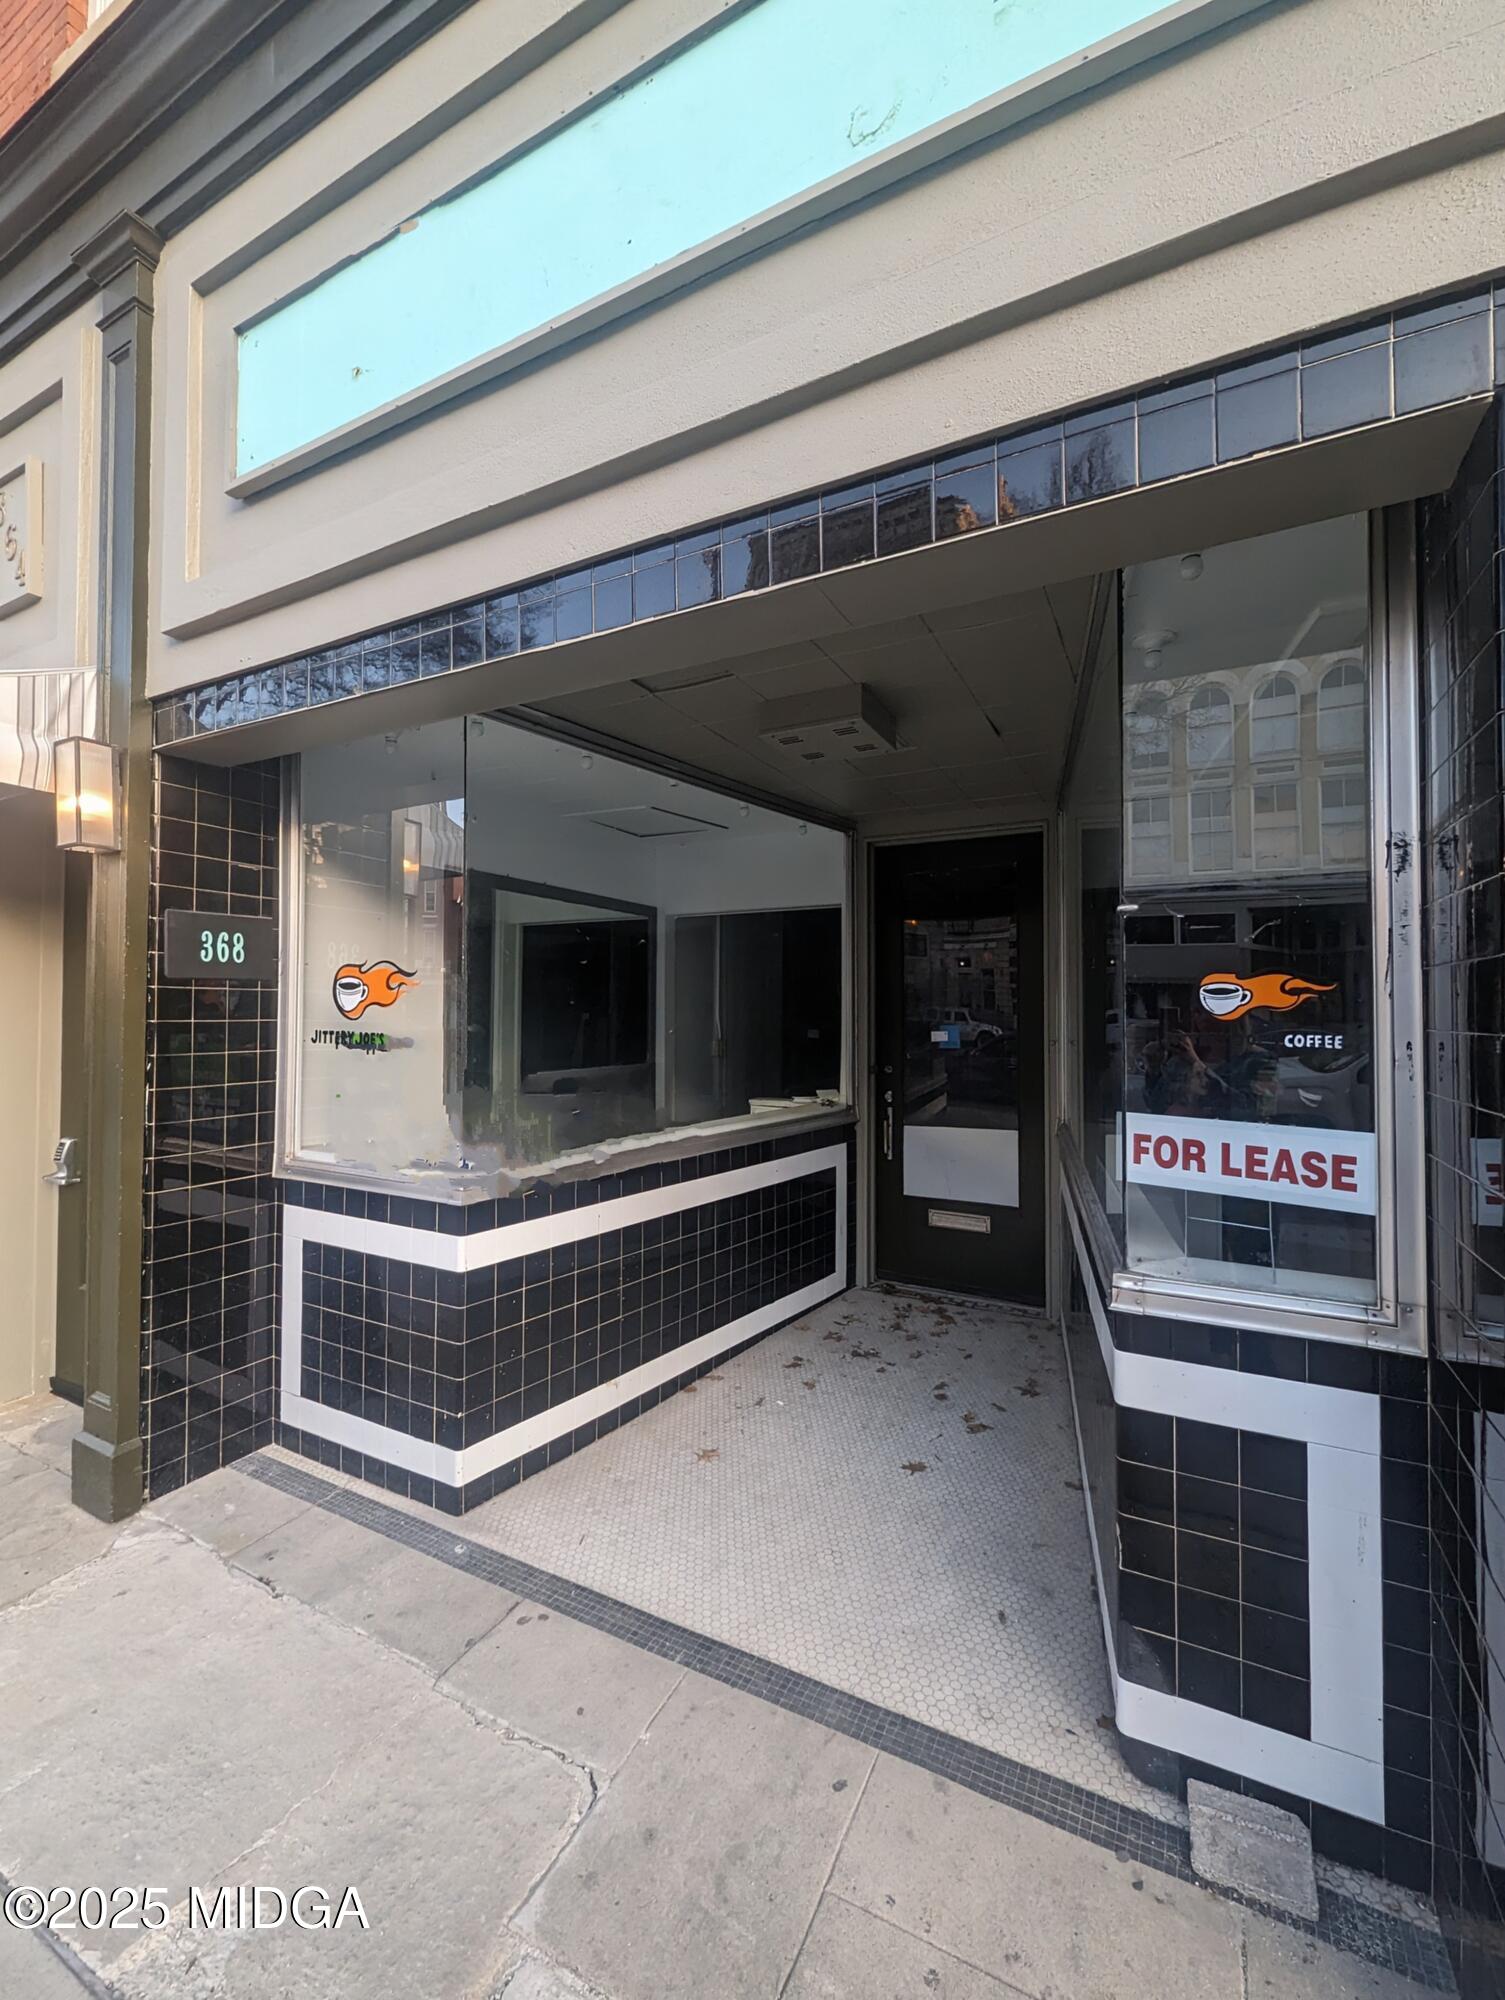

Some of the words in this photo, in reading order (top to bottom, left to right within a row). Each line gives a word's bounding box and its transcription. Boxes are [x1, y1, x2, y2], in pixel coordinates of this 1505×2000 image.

[200, 930, 245, 964] 368
[311, 1030, 354, 1046] JITTERY
[355, 1032, 385, 1046] JOE'S
[1284, 1034, 1343, 1049] COFFEE
[1132, 1133, 1206, 1173] FOR
[1220, 1142, 1358, 1193] LEASE
